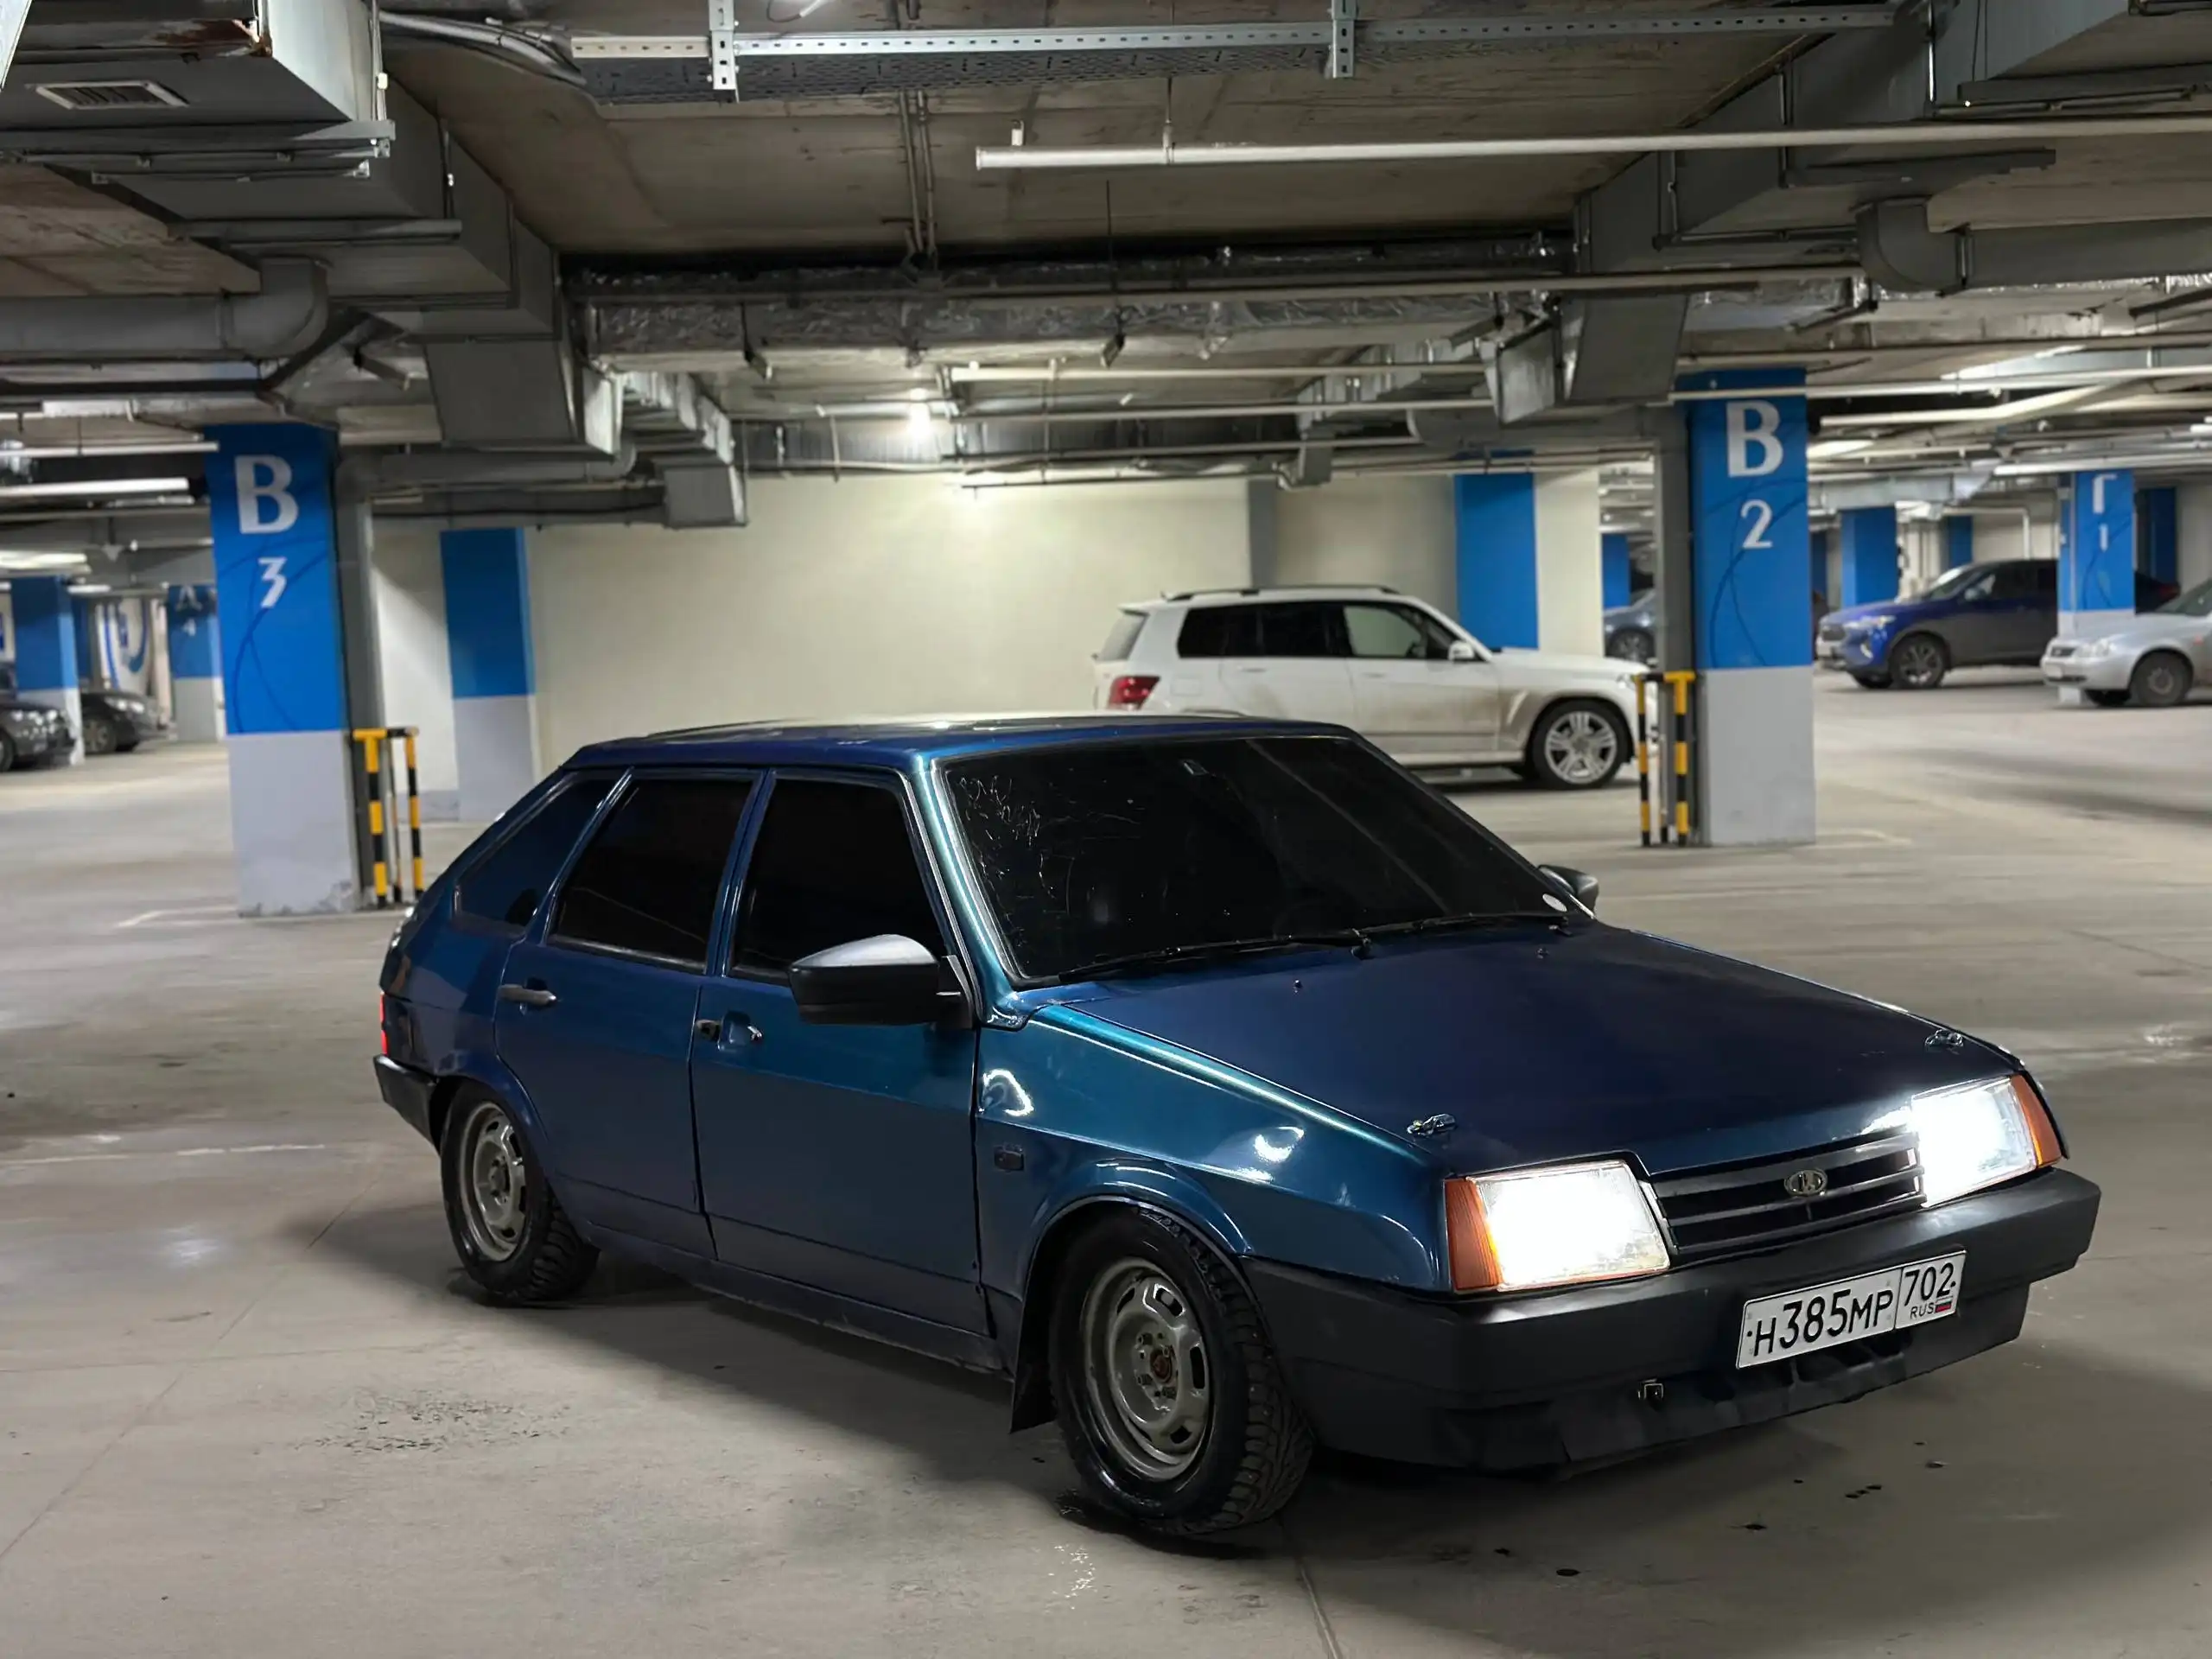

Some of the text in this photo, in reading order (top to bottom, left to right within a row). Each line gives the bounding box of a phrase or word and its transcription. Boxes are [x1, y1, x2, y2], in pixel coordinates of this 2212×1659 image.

[1740, 499, 1773, 549] 2
[258, 557, 287, 608] 3
[1753, 1262, 1955, 1356] Н385МР 702
[1910, 1303, 1935, 1319] RUS
